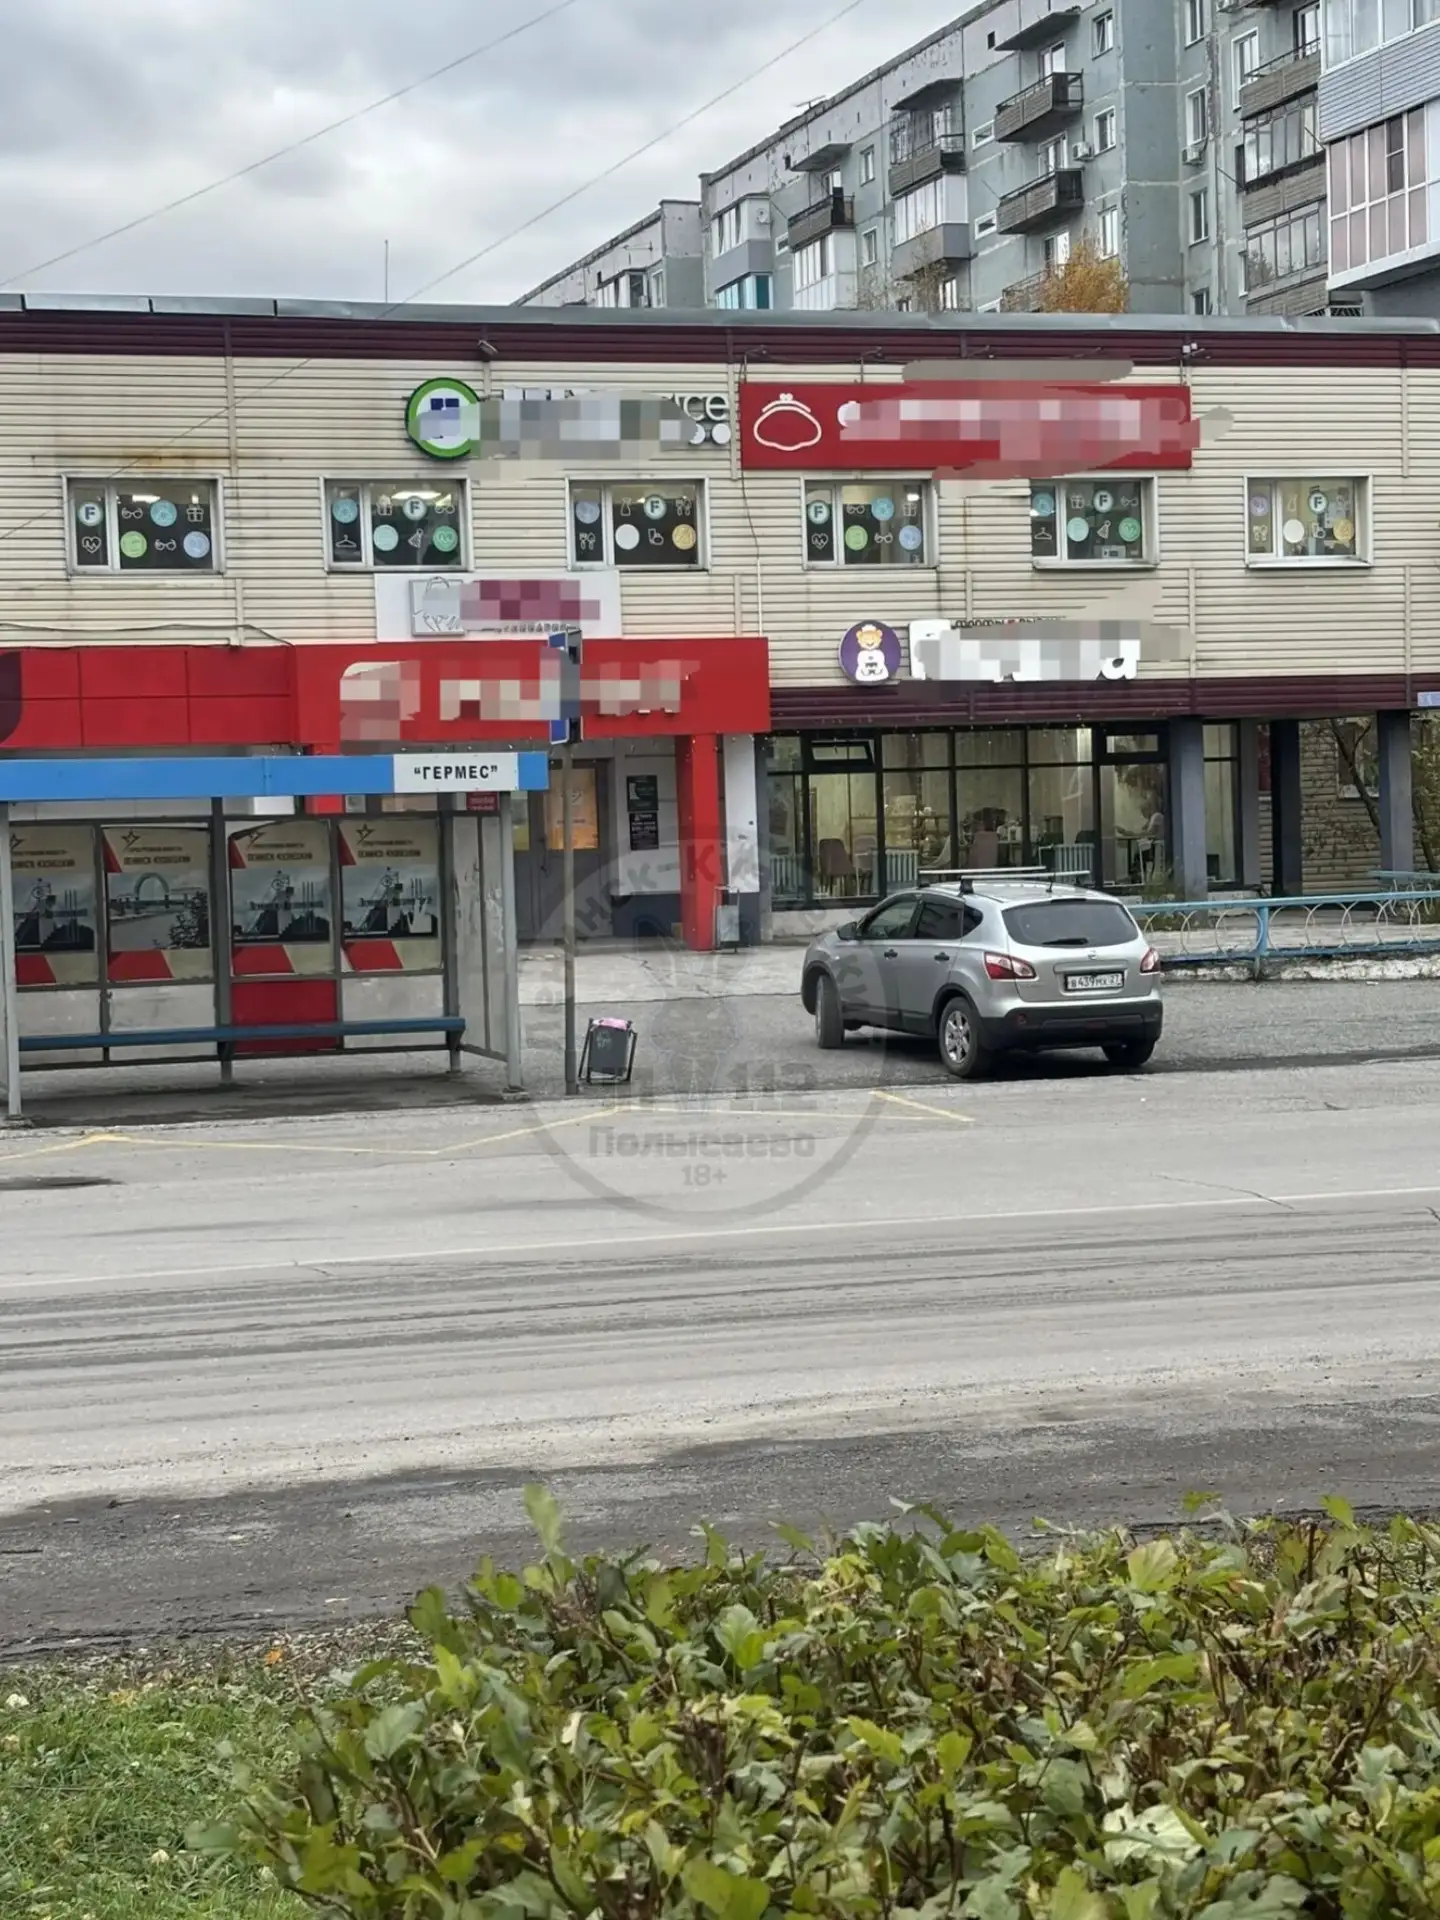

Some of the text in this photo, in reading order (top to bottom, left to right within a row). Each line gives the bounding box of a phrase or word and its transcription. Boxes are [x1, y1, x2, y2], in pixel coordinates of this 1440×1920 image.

[410, 501, 420, 514] F
[650, 500, 659, 513] F
[1099, 495, 1107, 507] F
[1314, 496, 1322, 509] F
[85, 506, 95, 520] F
[814, 505, 823, 518] F
[414, 764, 498, 780] “ГЕРМЕС”
